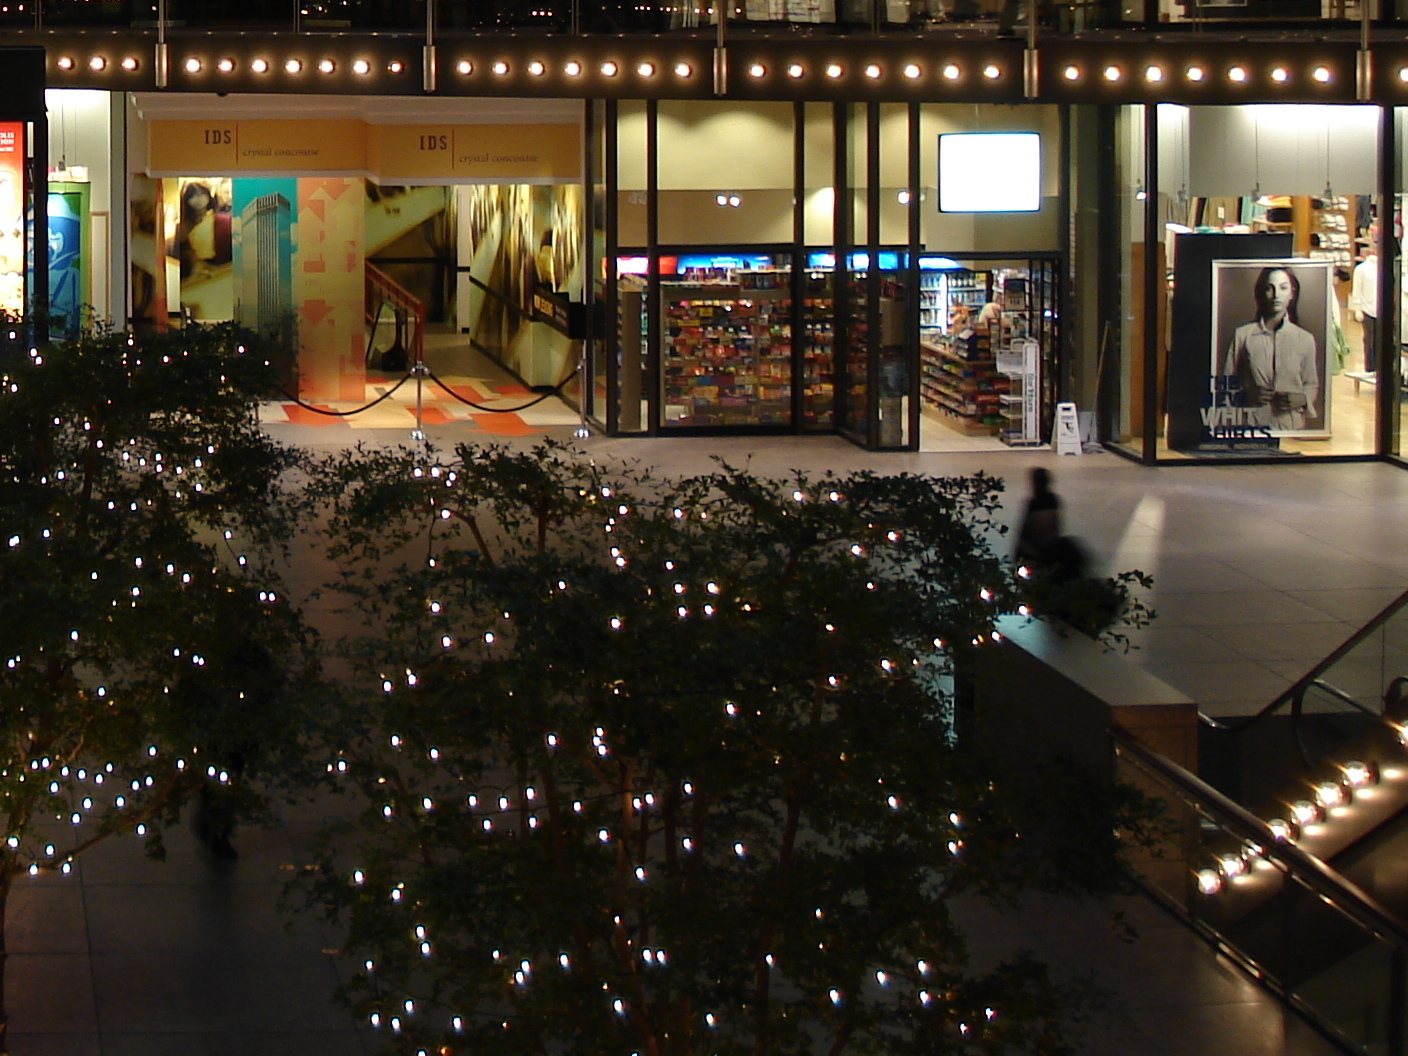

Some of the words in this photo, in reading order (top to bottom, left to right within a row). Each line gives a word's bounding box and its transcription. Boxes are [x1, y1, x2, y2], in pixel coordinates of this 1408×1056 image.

[204, 129, 232, 145] IDS
[419, 134, 448, 151] IDS
[242, 147, 273, 158] crystal
[274, 149, 320, 157] concourse
[458, 152, 489, 164] crystal
[491, 155, 539, 164] concourse
